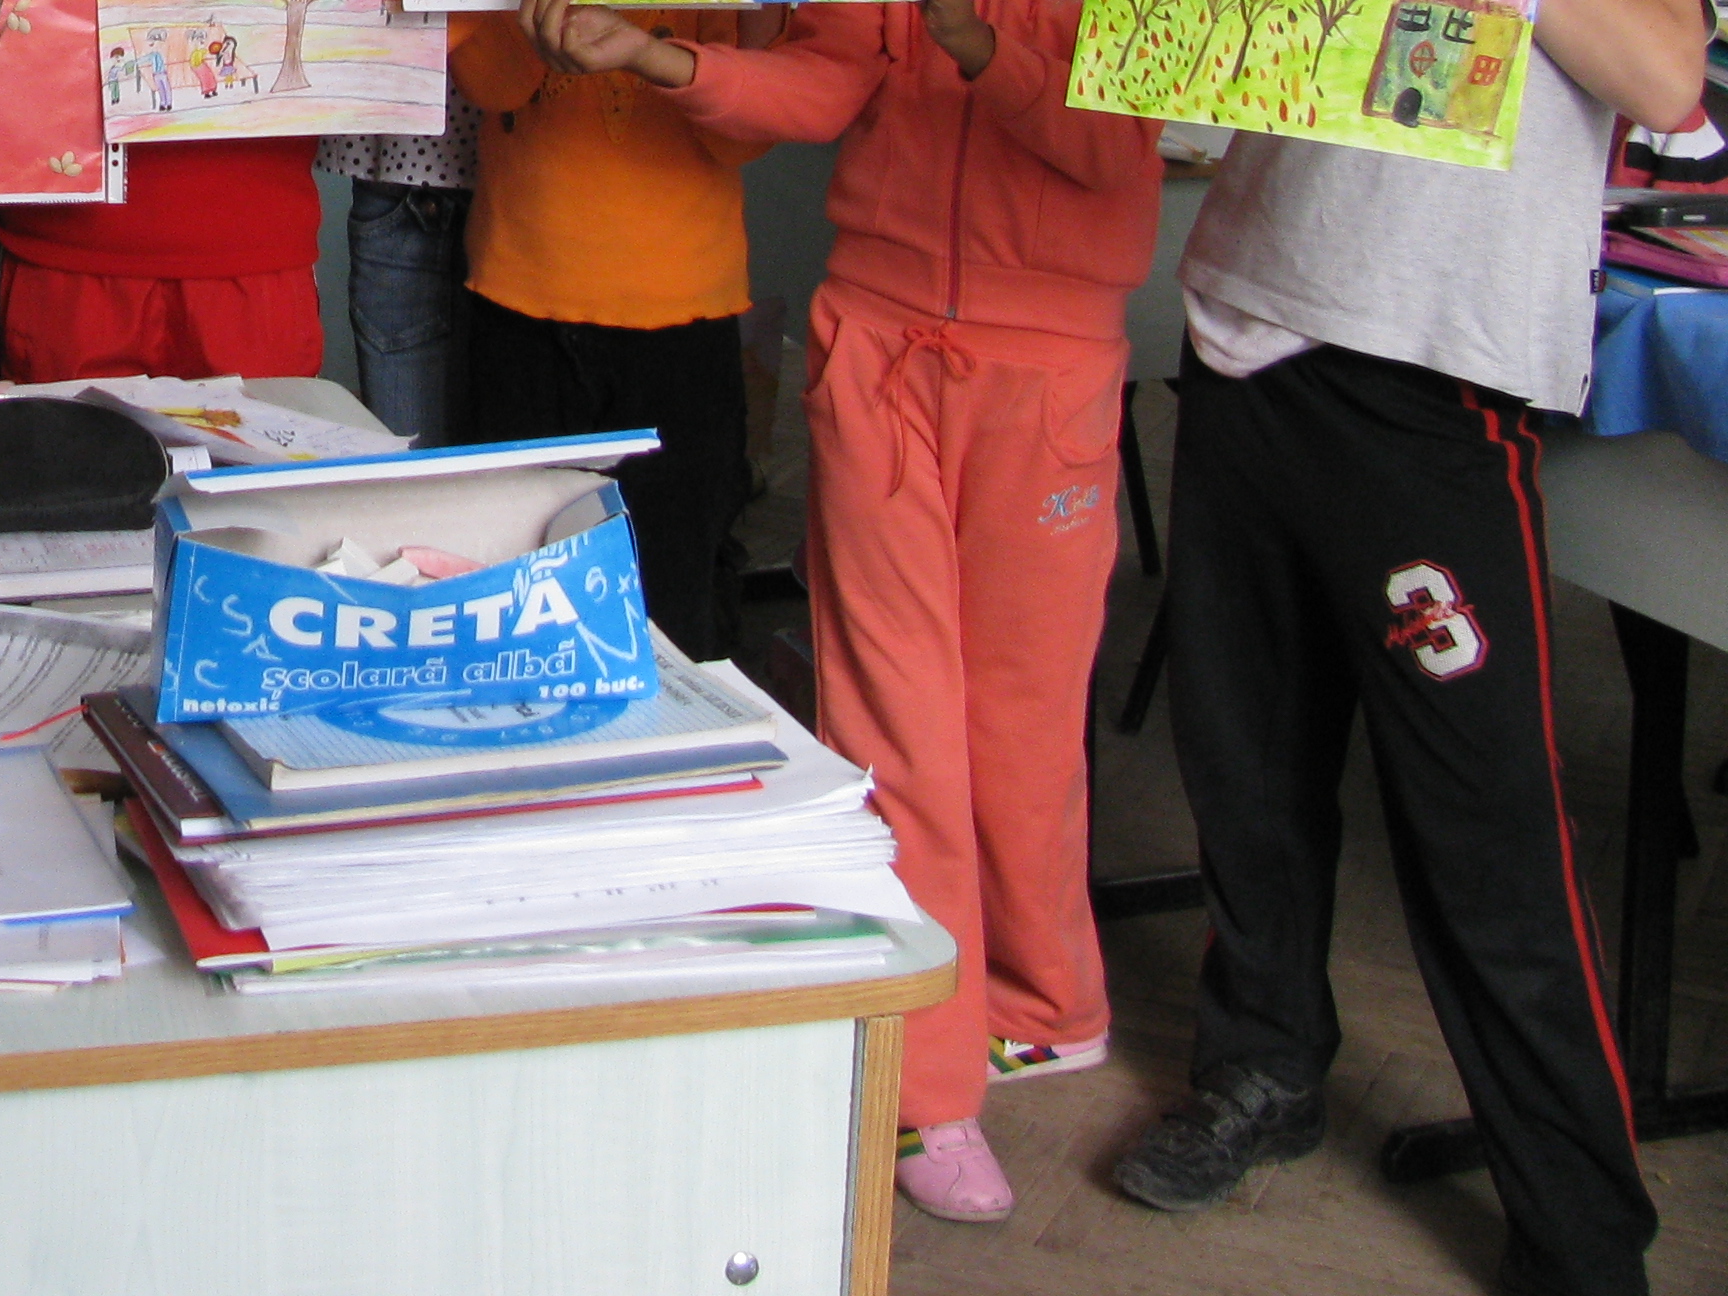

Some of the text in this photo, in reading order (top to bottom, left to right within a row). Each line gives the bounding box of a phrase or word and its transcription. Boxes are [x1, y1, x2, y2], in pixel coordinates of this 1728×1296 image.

[1384, 559, 1489, 682] 3
[538, 682, 587, 700] 100
[182, 697, 280, 713] netoxic
